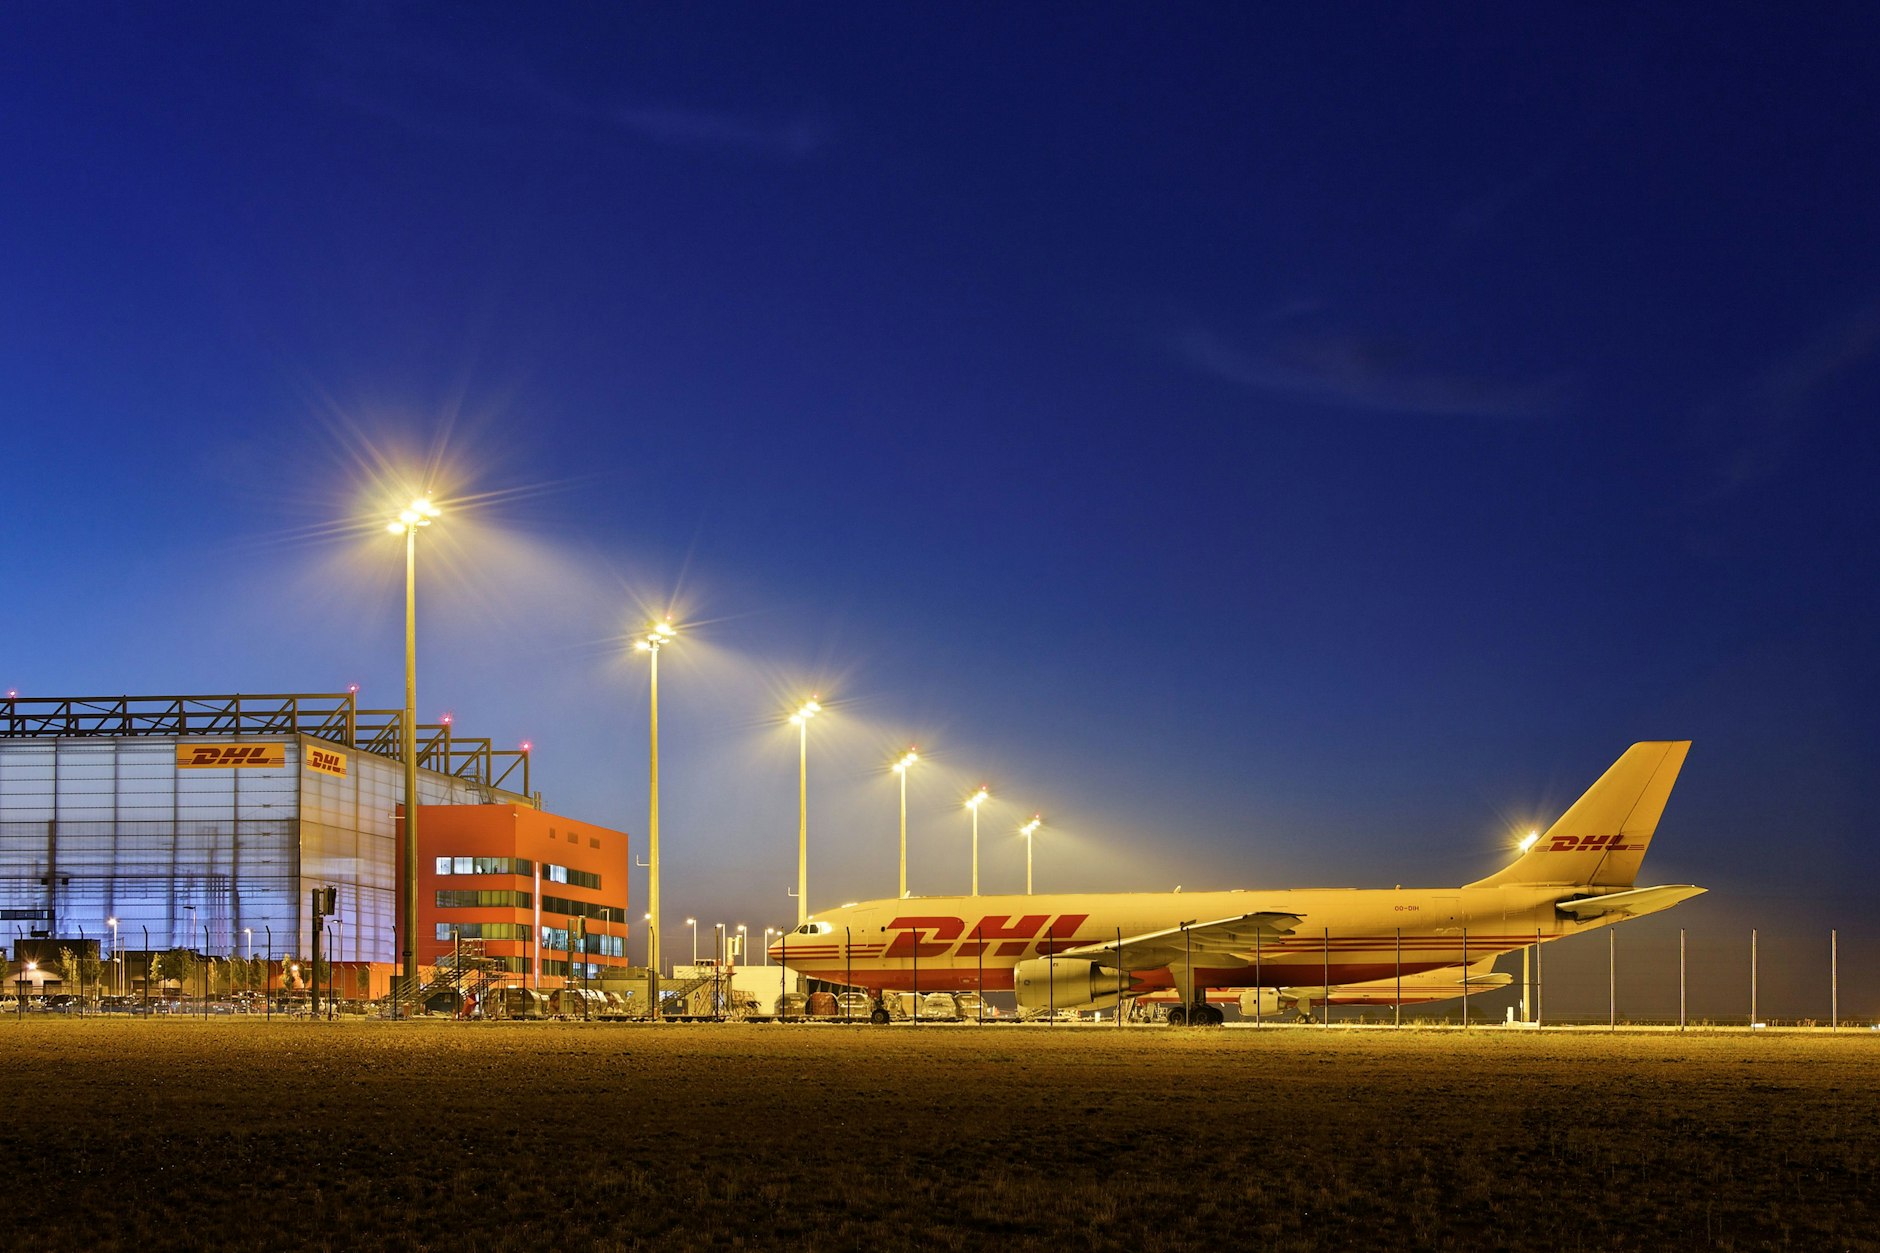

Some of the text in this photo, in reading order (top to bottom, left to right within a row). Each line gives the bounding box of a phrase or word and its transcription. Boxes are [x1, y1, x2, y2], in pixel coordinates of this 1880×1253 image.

[191, 747, 270, 765] DHL
[312, 751, 342, 773] DHL
[1549, 835, 1630, 851] DHL
[885, 914, 1103, 957] DHL
